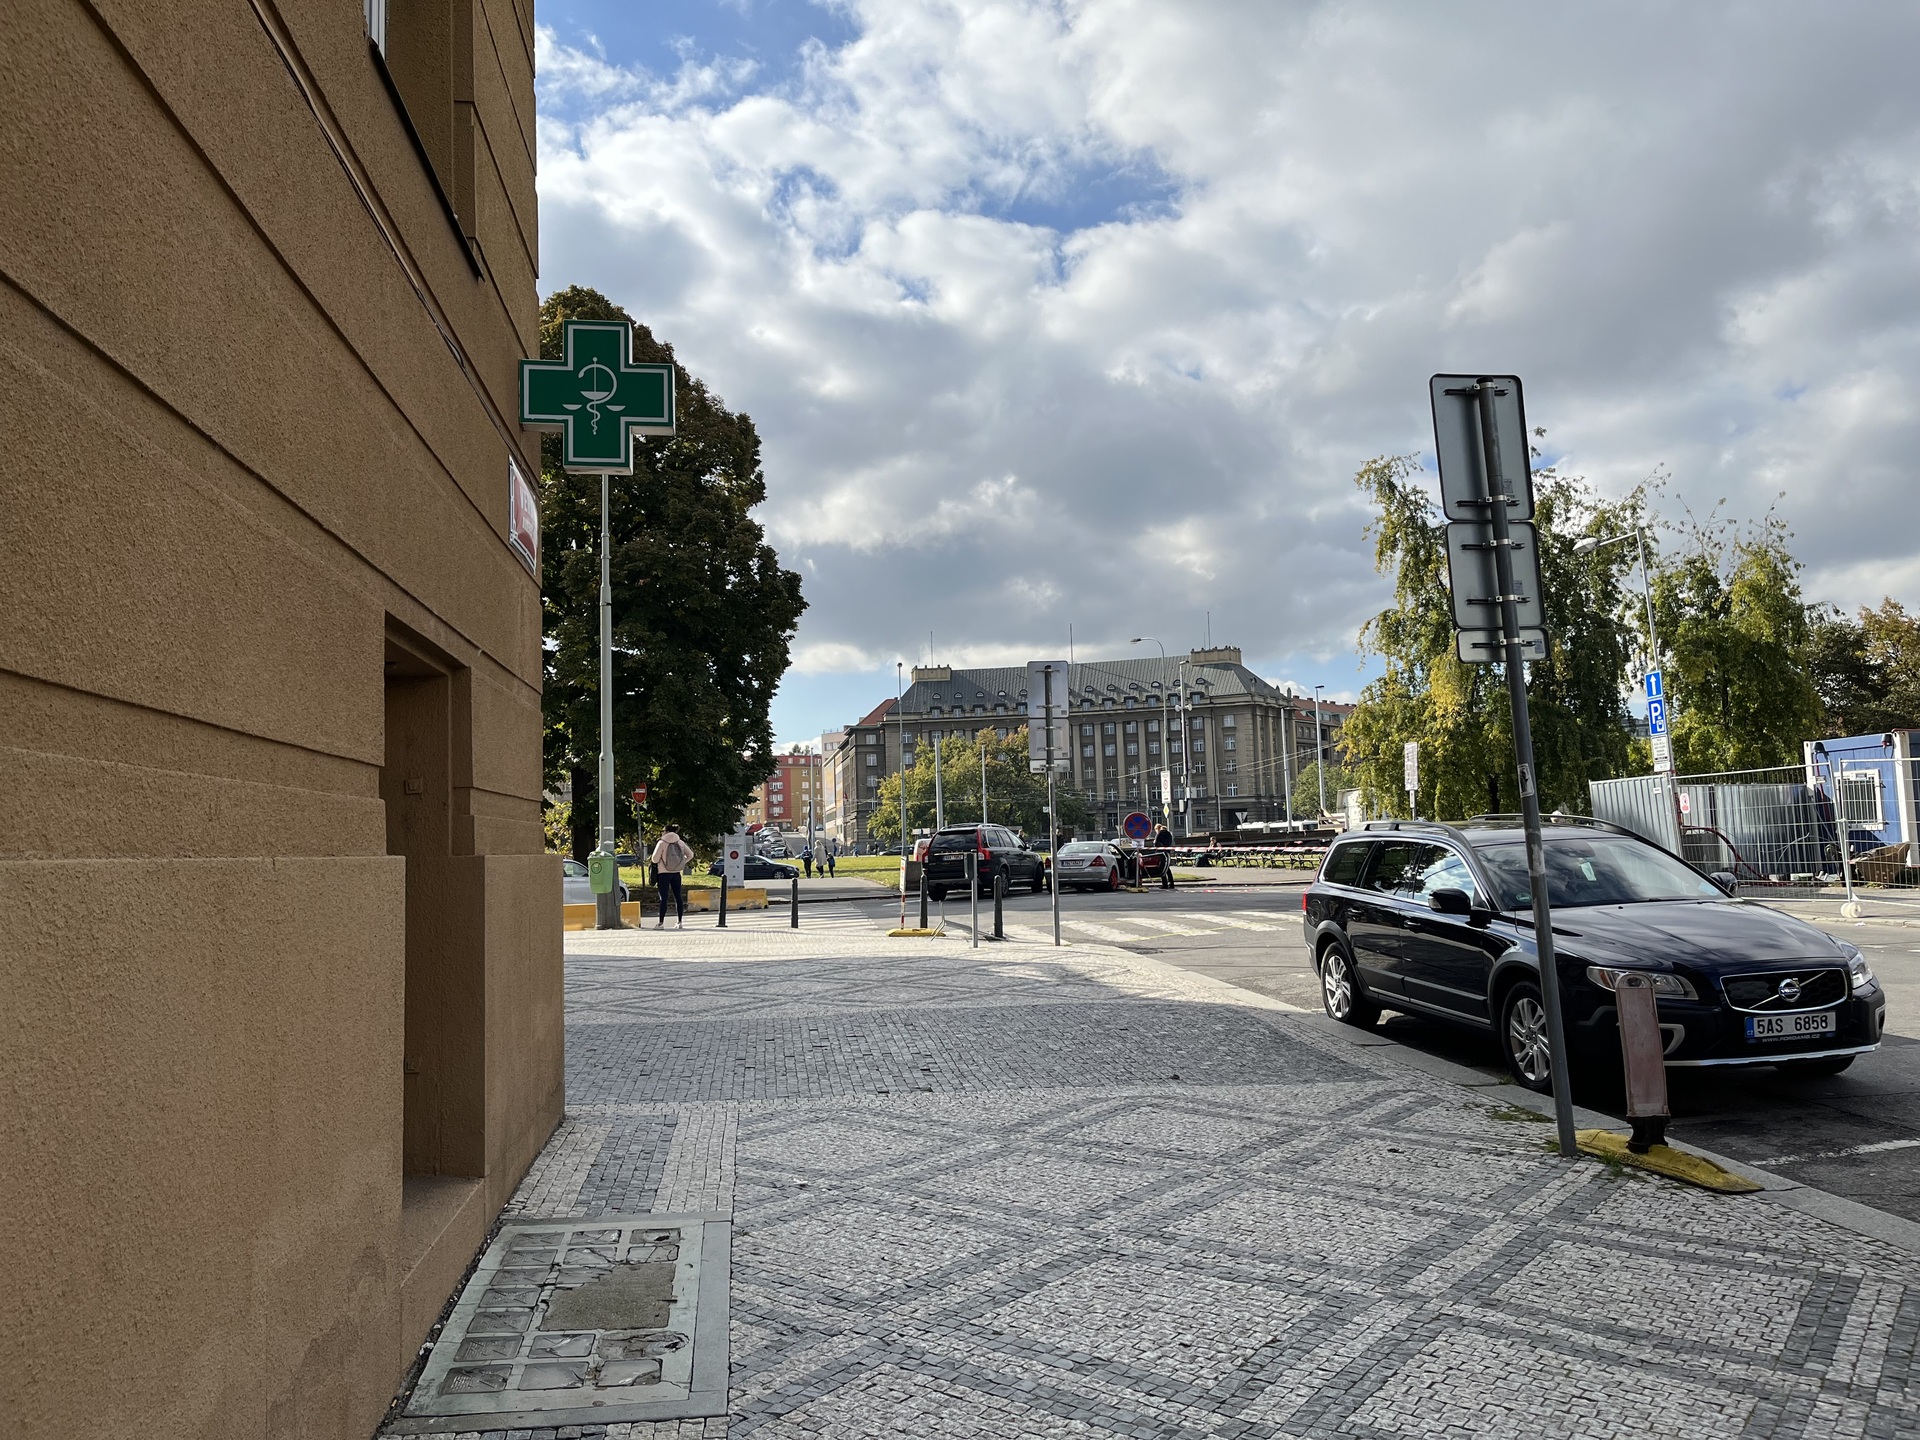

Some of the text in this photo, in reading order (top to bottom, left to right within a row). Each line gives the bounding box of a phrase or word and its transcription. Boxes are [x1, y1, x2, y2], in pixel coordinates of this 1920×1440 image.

[1650, 702, 1661, 725] P
[1757, 1015, 1828, 1034] 5AS 6858
